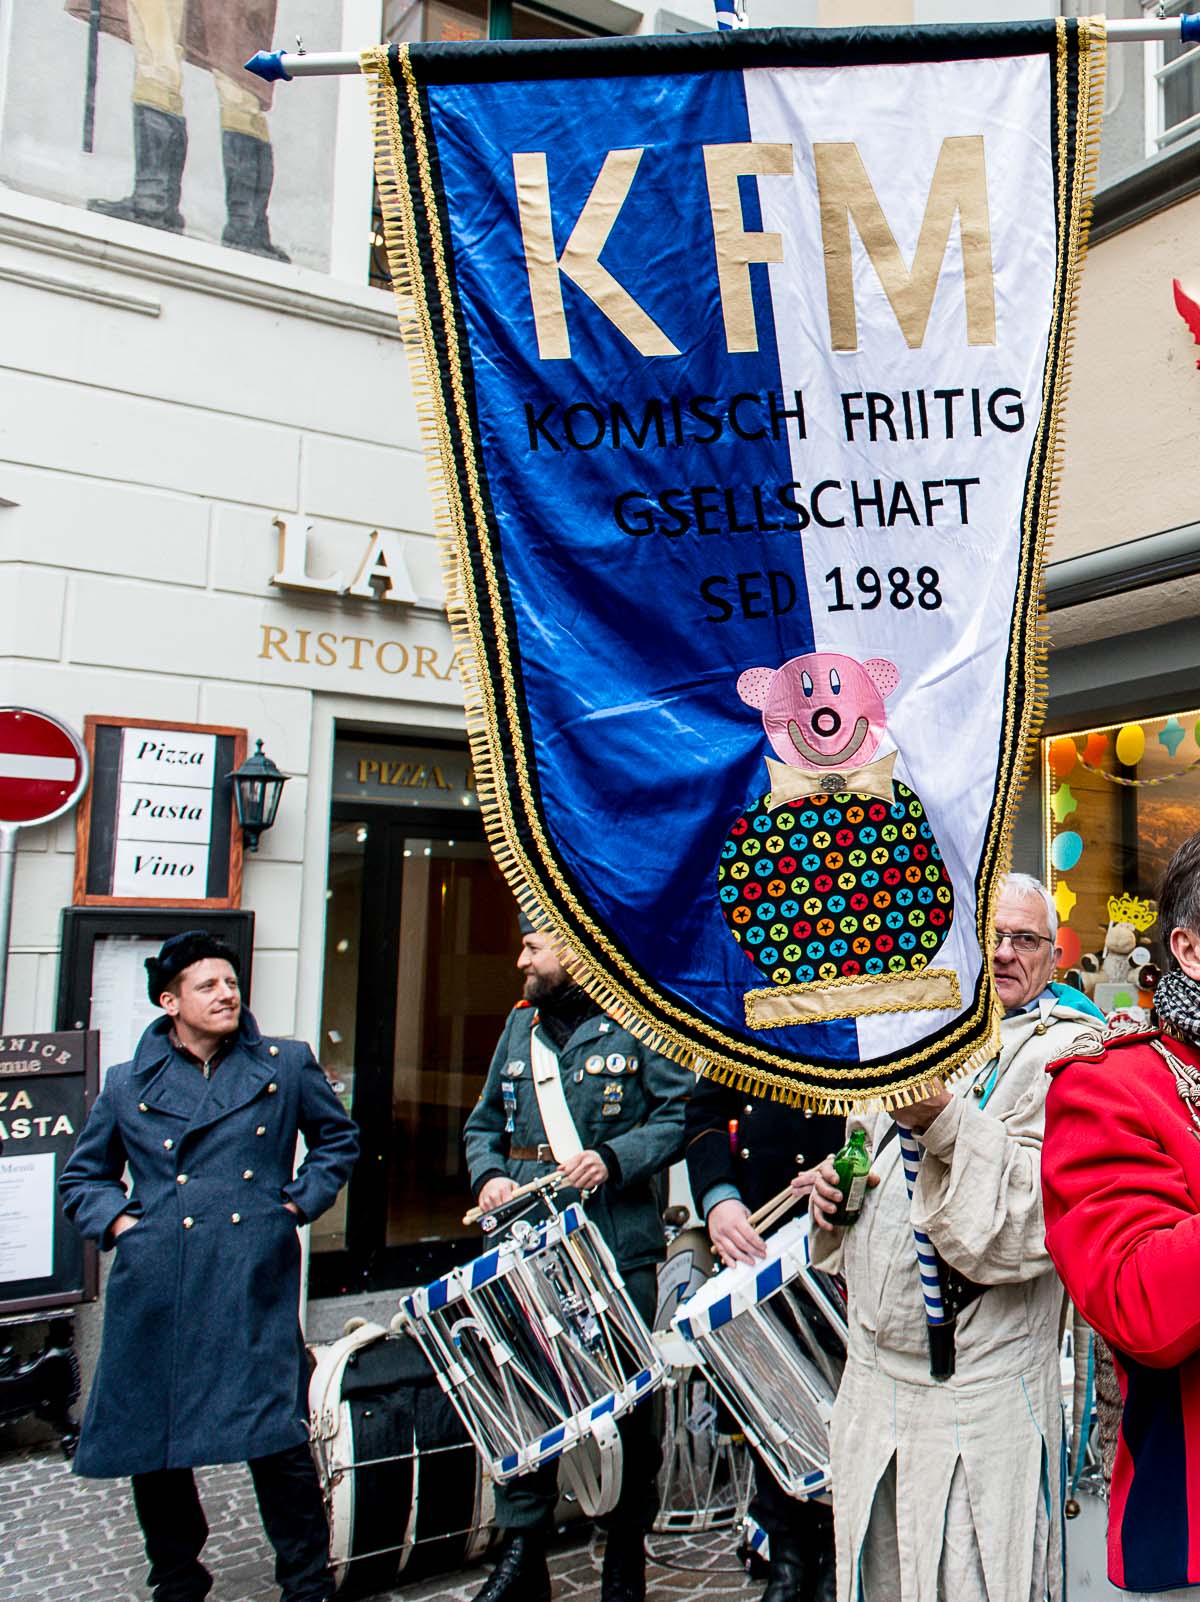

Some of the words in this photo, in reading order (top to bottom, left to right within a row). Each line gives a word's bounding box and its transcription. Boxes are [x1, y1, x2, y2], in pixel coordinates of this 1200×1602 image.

[512, 135, 997, 360] KFM
[526, 389, 807, 452] KOMISCH
[841, 387, 1025, 442] FRIITIG
[613, 477, 980, 538] GSELLSCHAFT
[268, 514, 419, 607] LA
[701, 570, 797, 624] SED
[825, 566, 943, 613] 1988
[136, 741, 205, 765] Pizza
[131, 798, 203, 821] Pasta
[133, 855, 195, 877] Vino
